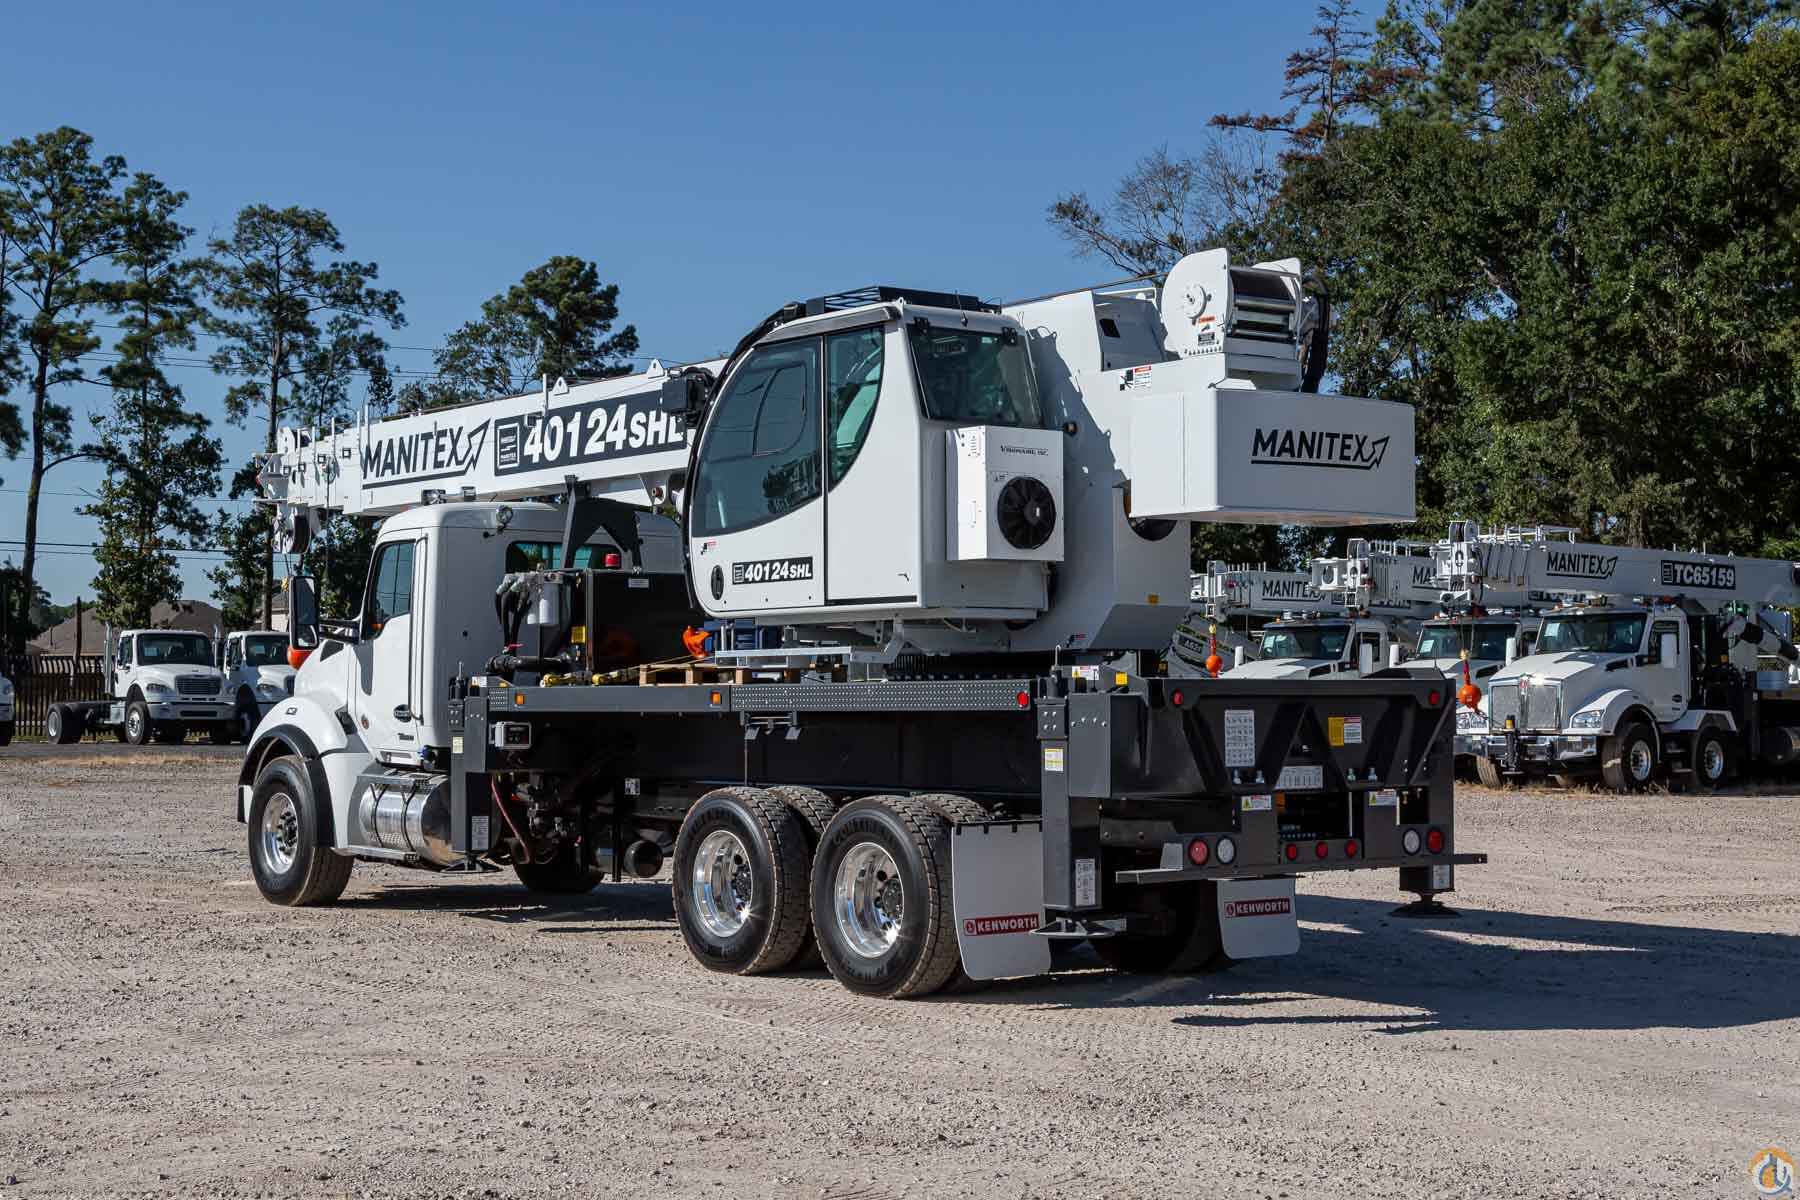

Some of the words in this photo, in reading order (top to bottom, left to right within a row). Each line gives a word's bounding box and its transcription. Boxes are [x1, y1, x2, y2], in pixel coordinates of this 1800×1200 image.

[523, 403, 684, 463] 40124SHL
[363, 426, 463, 480] MANITEX
[1252, 428, 1369, 462] MANITEX
[745, 561, 811, 581] 40124SHL
[1547, 552, 1604, 574] MANITEX
[1674, 564, 1735, 587] TC65159
[1236, 901, 1289, 914] KENWORTH
[977, 917, 1037, 932] KENWORTH
